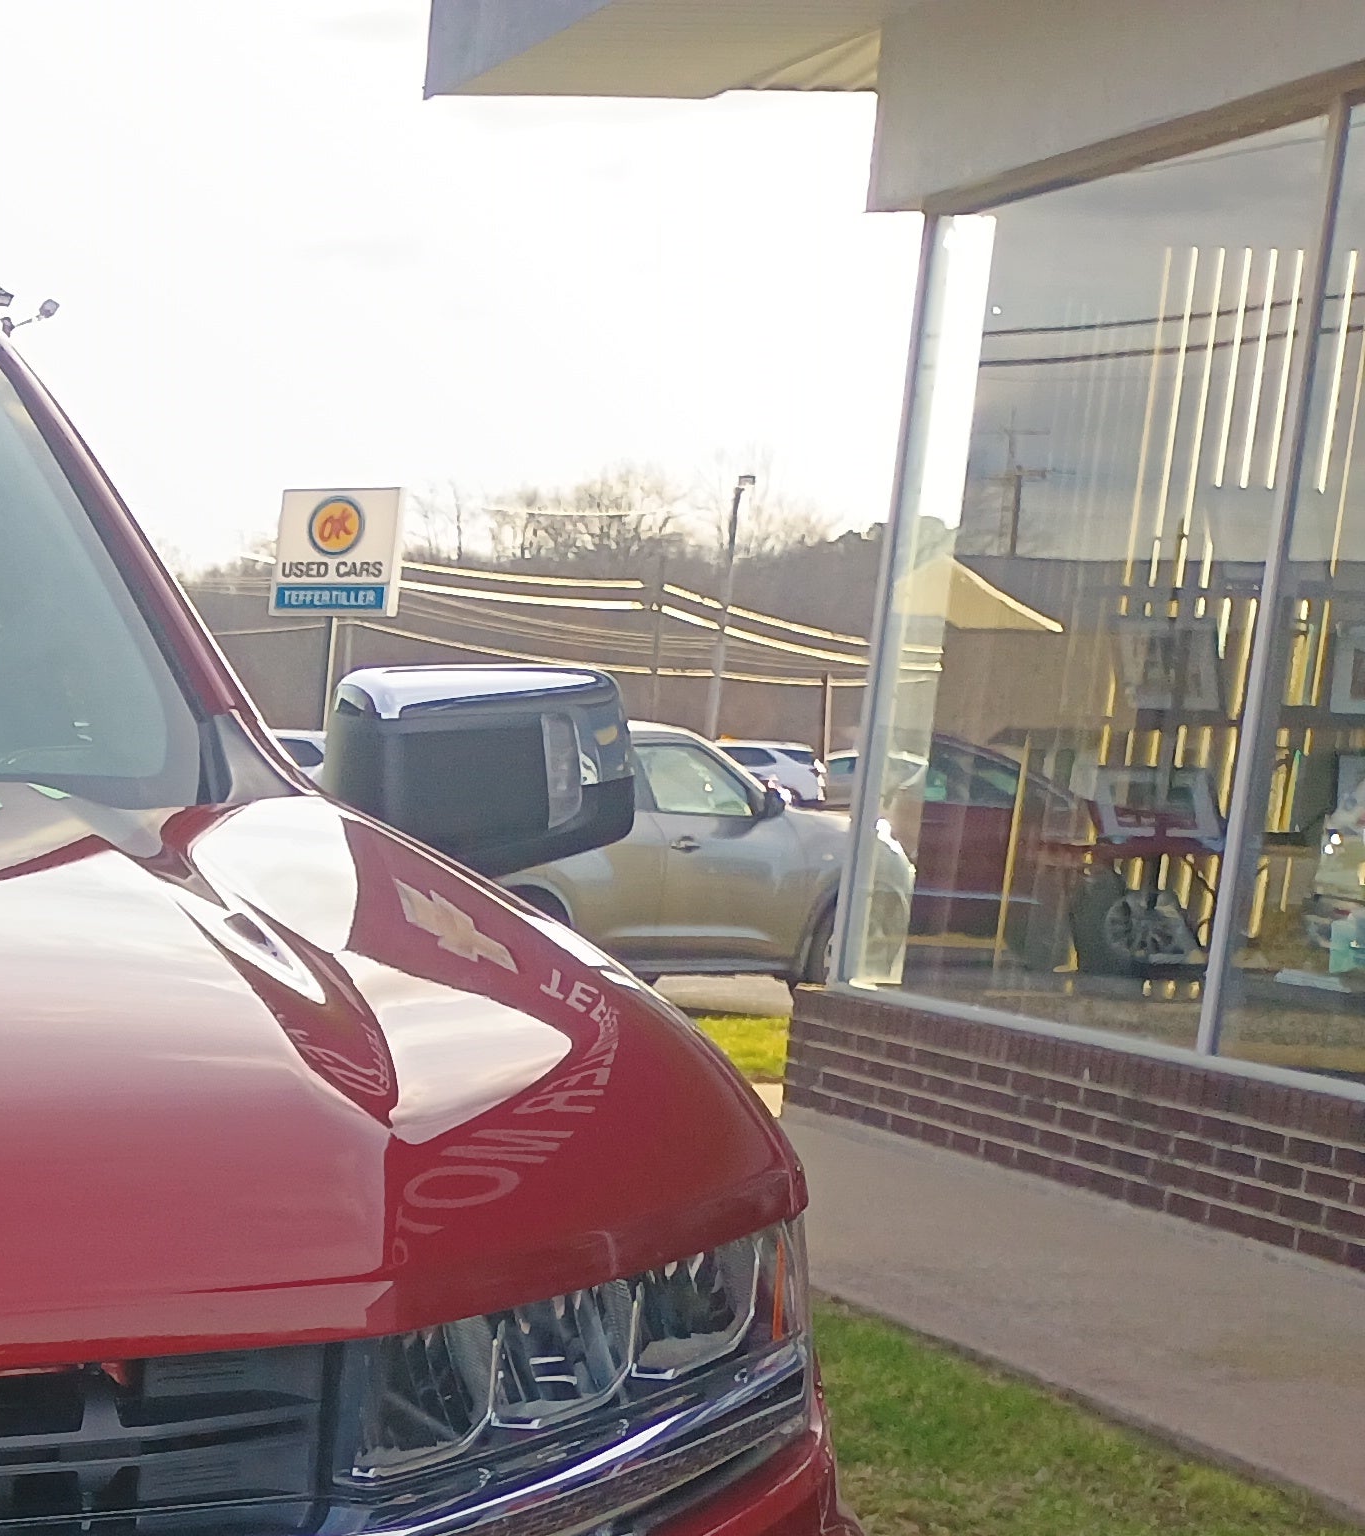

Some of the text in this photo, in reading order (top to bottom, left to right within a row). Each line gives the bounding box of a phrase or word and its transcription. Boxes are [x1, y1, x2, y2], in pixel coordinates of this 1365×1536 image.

[282, 561, 383, 578] USED CARS
[284, 590, 376, 605] TEFFERTILLER
